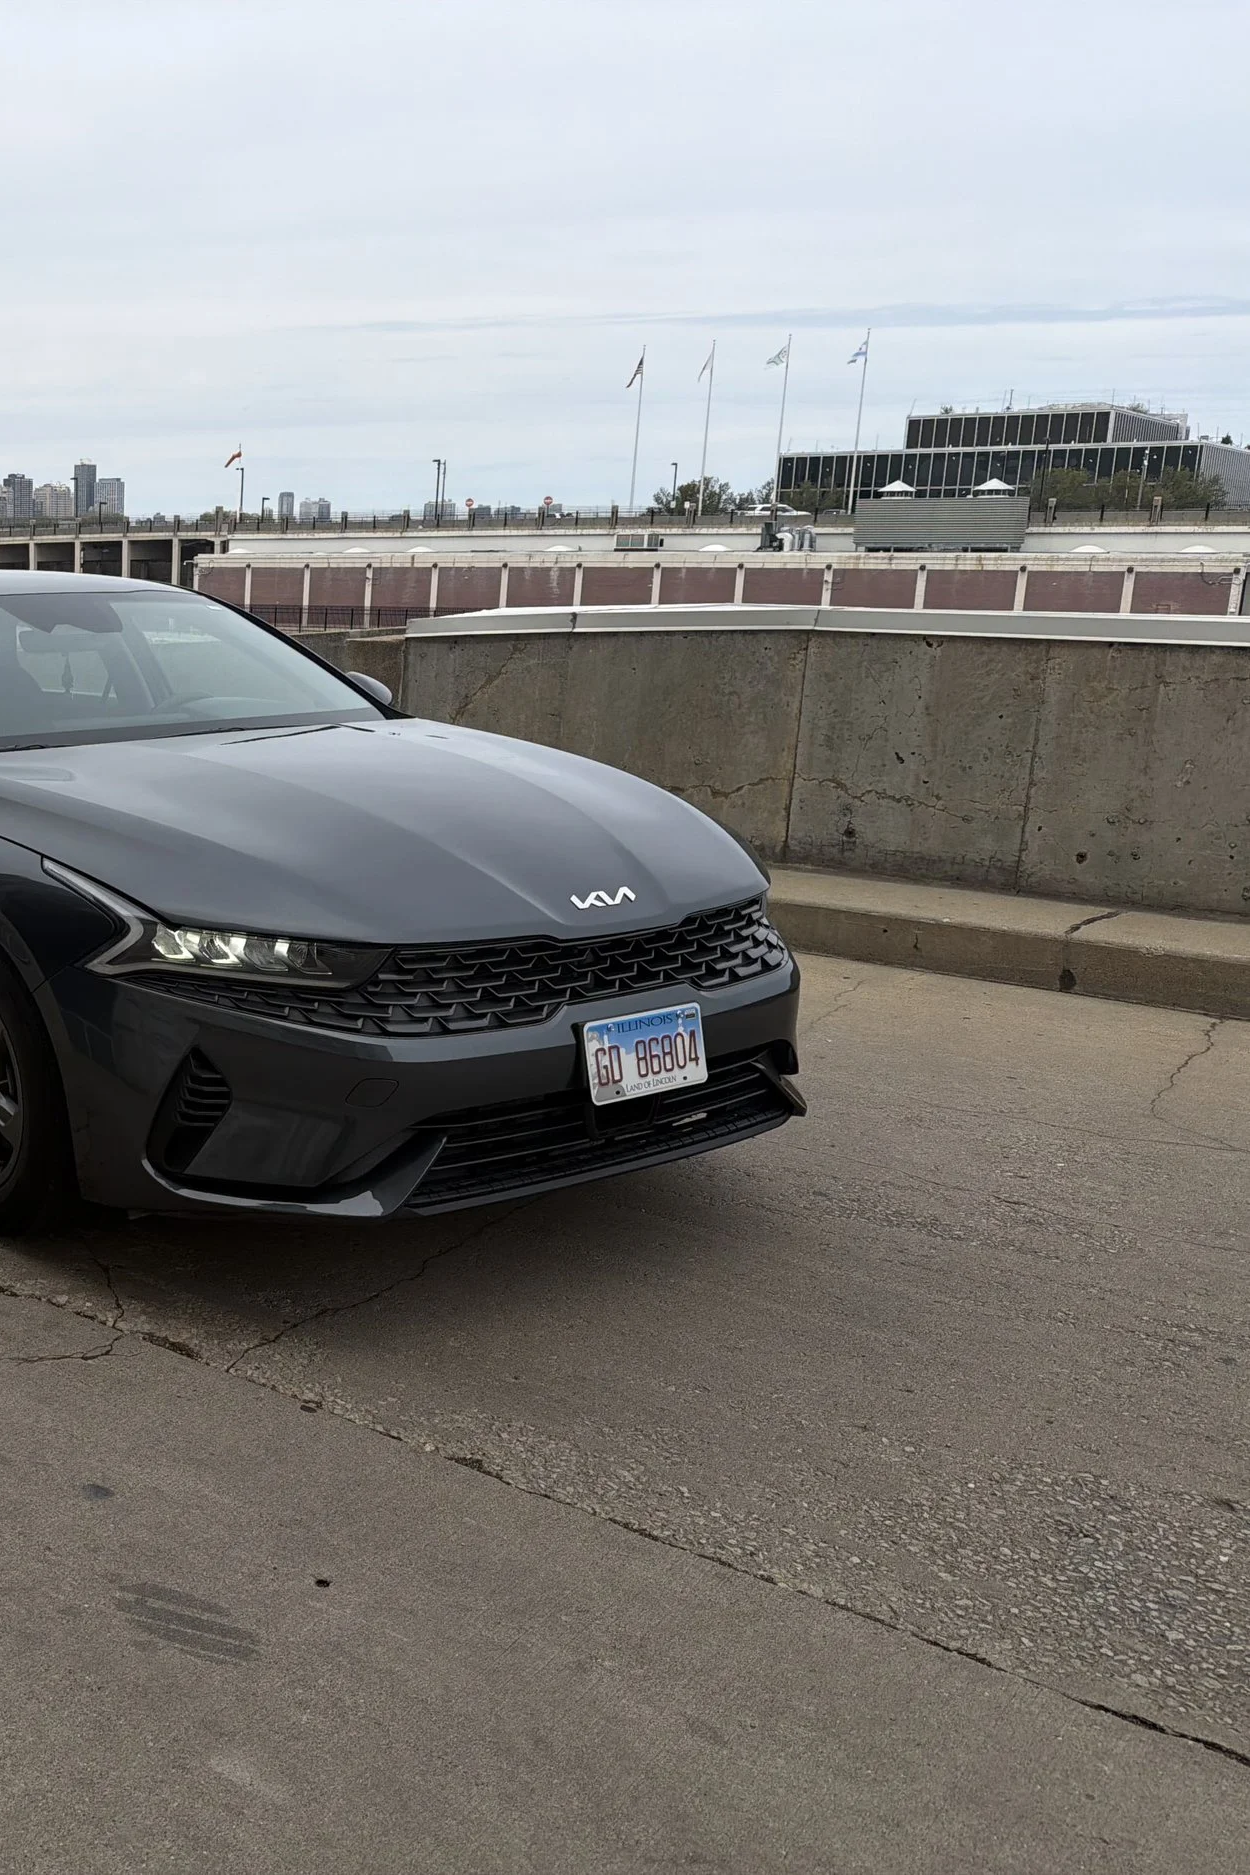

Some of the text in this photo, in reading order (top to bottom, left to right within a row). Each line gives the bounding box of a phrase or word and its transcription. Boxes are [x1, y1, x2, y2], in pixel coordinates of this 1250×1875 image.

[617, 1014, 673, 1033] ILLINOIS
[595, 1029, 700, 1087] GD 86804
[626, 1082, 643, 1093] LAND
[644, 1080, 652, 1088] OF
